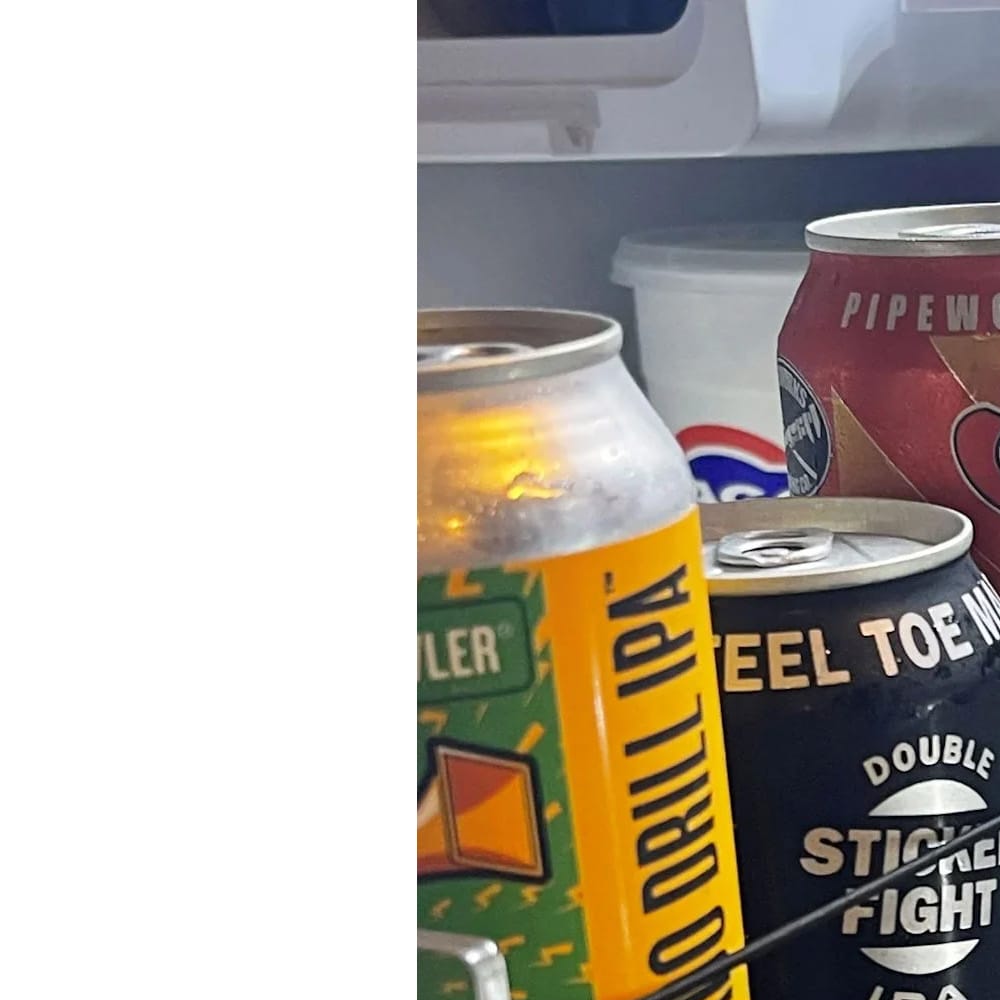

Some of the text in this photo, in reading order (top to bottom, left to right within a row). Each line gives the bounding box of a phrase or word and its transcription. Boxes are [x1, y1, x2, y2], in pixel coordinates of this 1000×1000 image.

[859, 601, 974, 677] TOE
[862, 734, 996, 786] DOUBLE
[624, 692, 720, 915] DRILL
[841, 877, 998, 935] FIGHT
